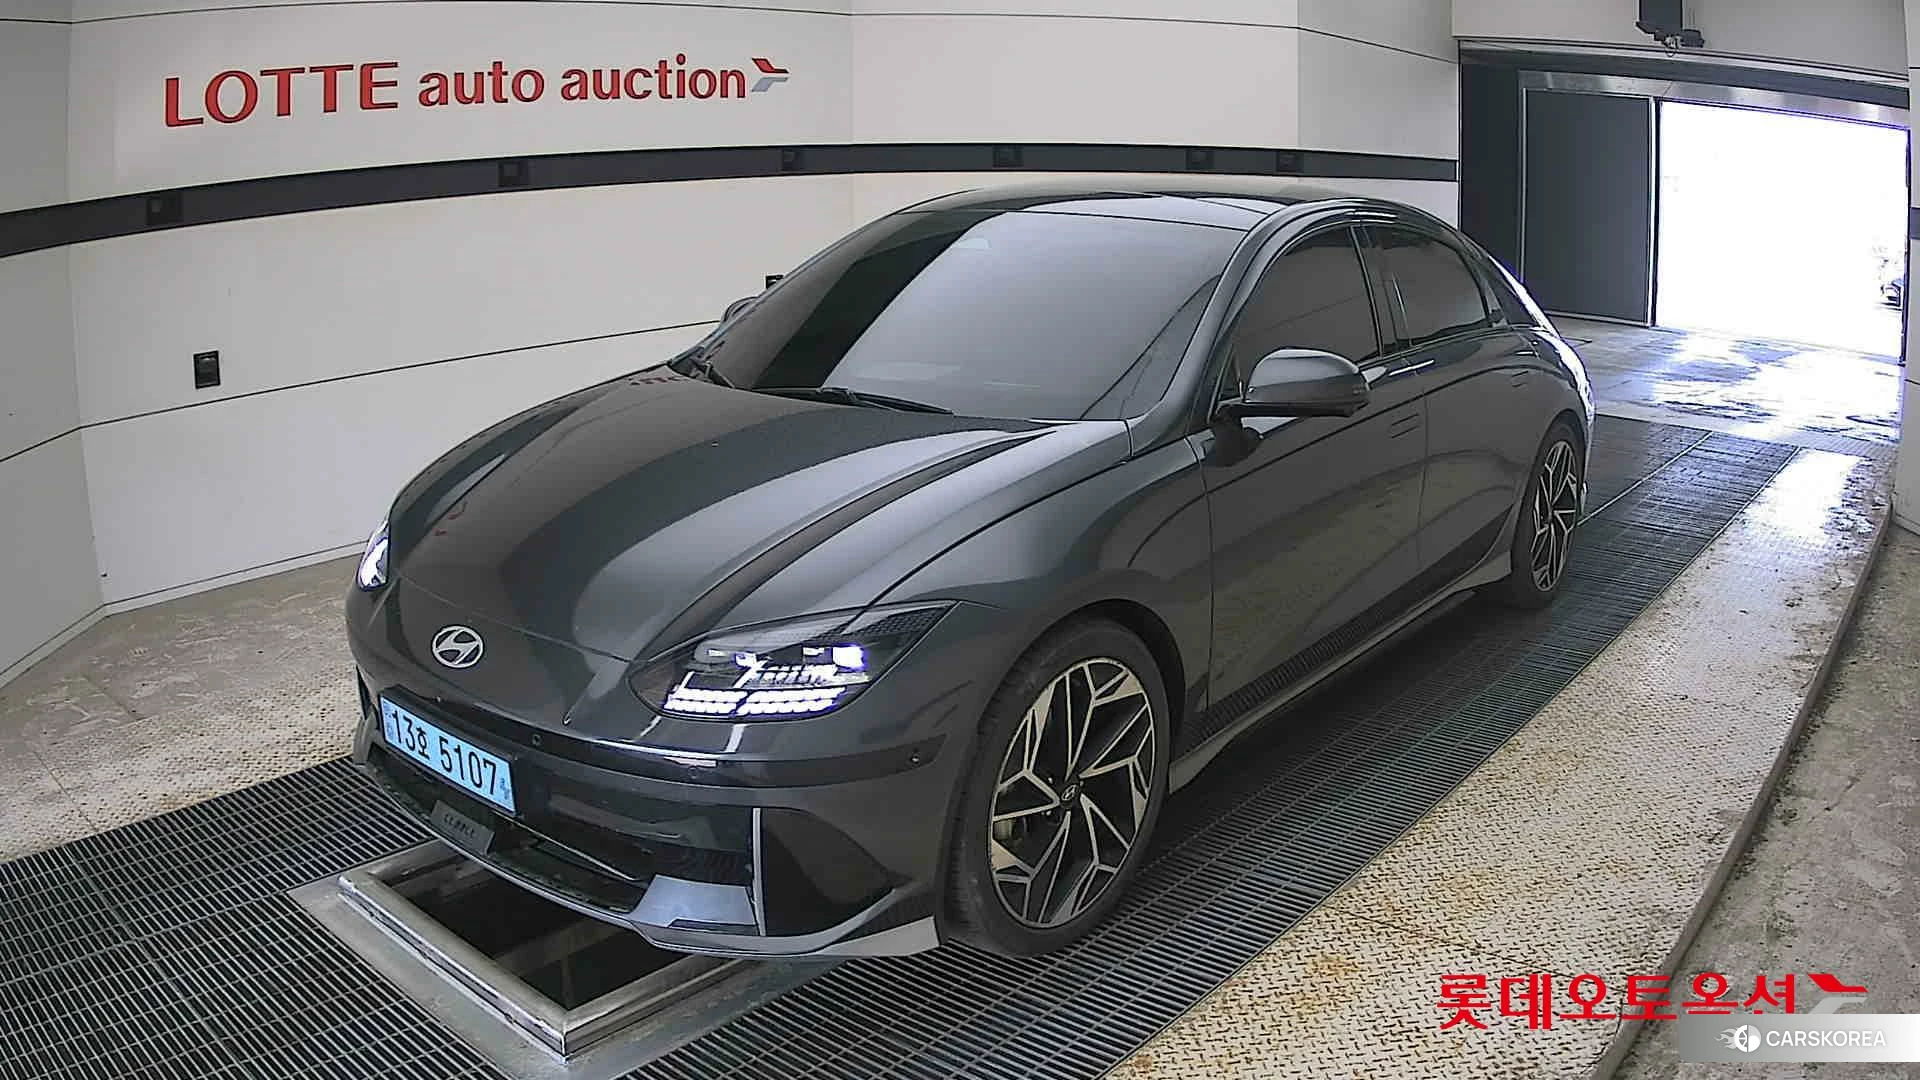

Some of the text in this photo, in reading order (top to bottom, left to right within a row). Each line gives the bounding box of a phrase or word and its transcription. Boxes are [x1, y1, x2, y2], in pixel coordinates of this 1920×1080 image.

[165, 54, 747, 128] LOTTE auto auction
[392, 710, 496, 795] 13호 5107
